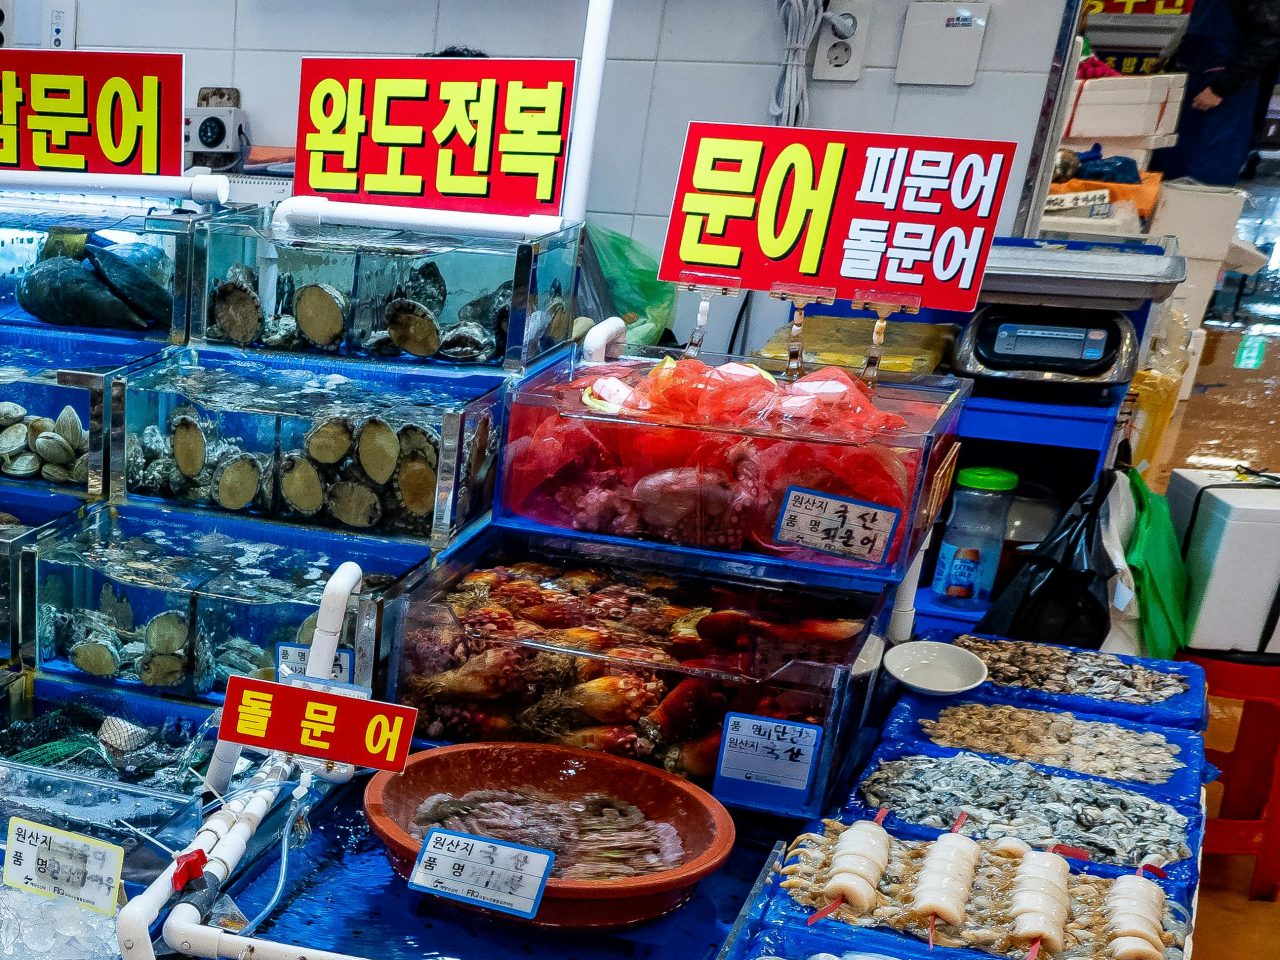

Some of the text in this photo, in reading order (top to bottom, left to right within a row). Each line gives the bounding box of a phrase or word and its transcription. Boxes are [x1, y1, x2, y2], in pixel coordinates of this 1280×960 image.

[305, 78, 563, 200] 완도전복
[855, 147, 1004, 217] 피문어
[679, 137, 846, 274] 문어
[840, 218, 985, 289] 돌문어
[792, 494, 879, 531] 원산지 국산
[821, 527, 878, 554] 피문어
[728, 737, 759, 752] 원산지
[16, 827, 52, 851] 원산지
[432, 836, 530, 871] 원산지 국산
